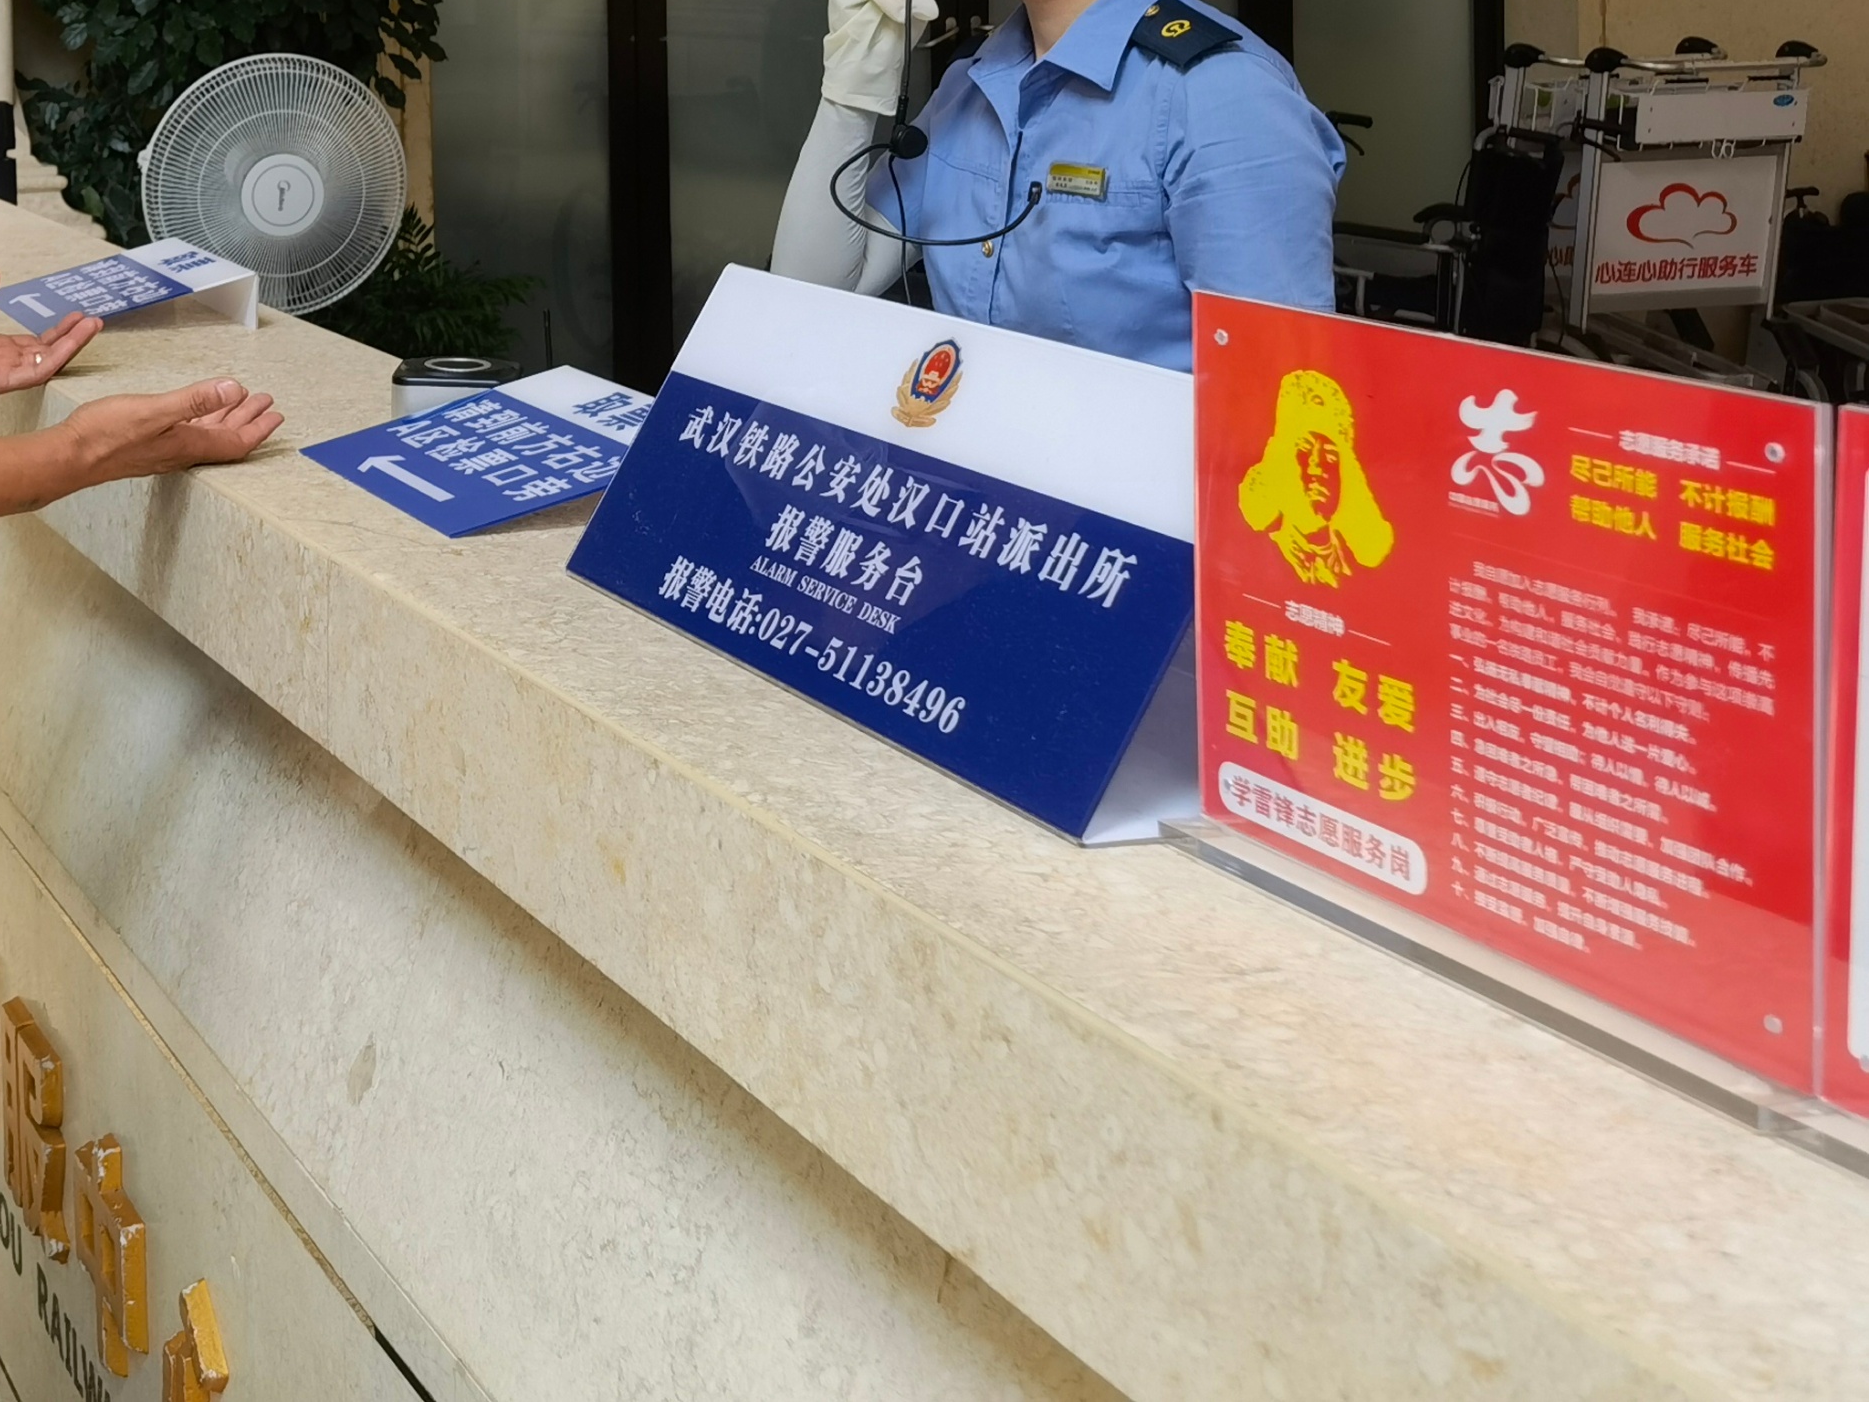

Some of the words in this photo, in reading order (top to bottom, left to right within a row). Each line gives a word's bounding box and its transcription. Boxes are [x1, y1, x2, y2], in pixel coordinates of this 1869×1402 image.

[1595, 253, 1758, 285] 心连心助行服务车
[386, 419, 574, 502] A区检票口旁
[442, 398, 621, 484] 请到前方右边
[678, 405, 1139, 612] 武汉铁路公安处汉口站派出所
[1570, 454, 1658, 499] 尽己所能
[1680, 479, 1776, 527] 不计报酬
[1570, 495, 1657, 540] 帮助他人
[1680, 521, 1775, 571] 服务社会
[749, 555, 794, 588] ALARM
[797, 573, 855, 616] SERVICE
[858, 601, 902, 635] DESK
[764, 504, 924, 607] 报警服务台
[1224, 620, 1299, 688] 奉献
[1332, 658, 1415, 733] 友爱
[1226, 689, 1299, 762] 互助
[1332, 732, 1416, 801] 进步
[1231, 775, 1411, 882] 学雷锋志愿服务岗
